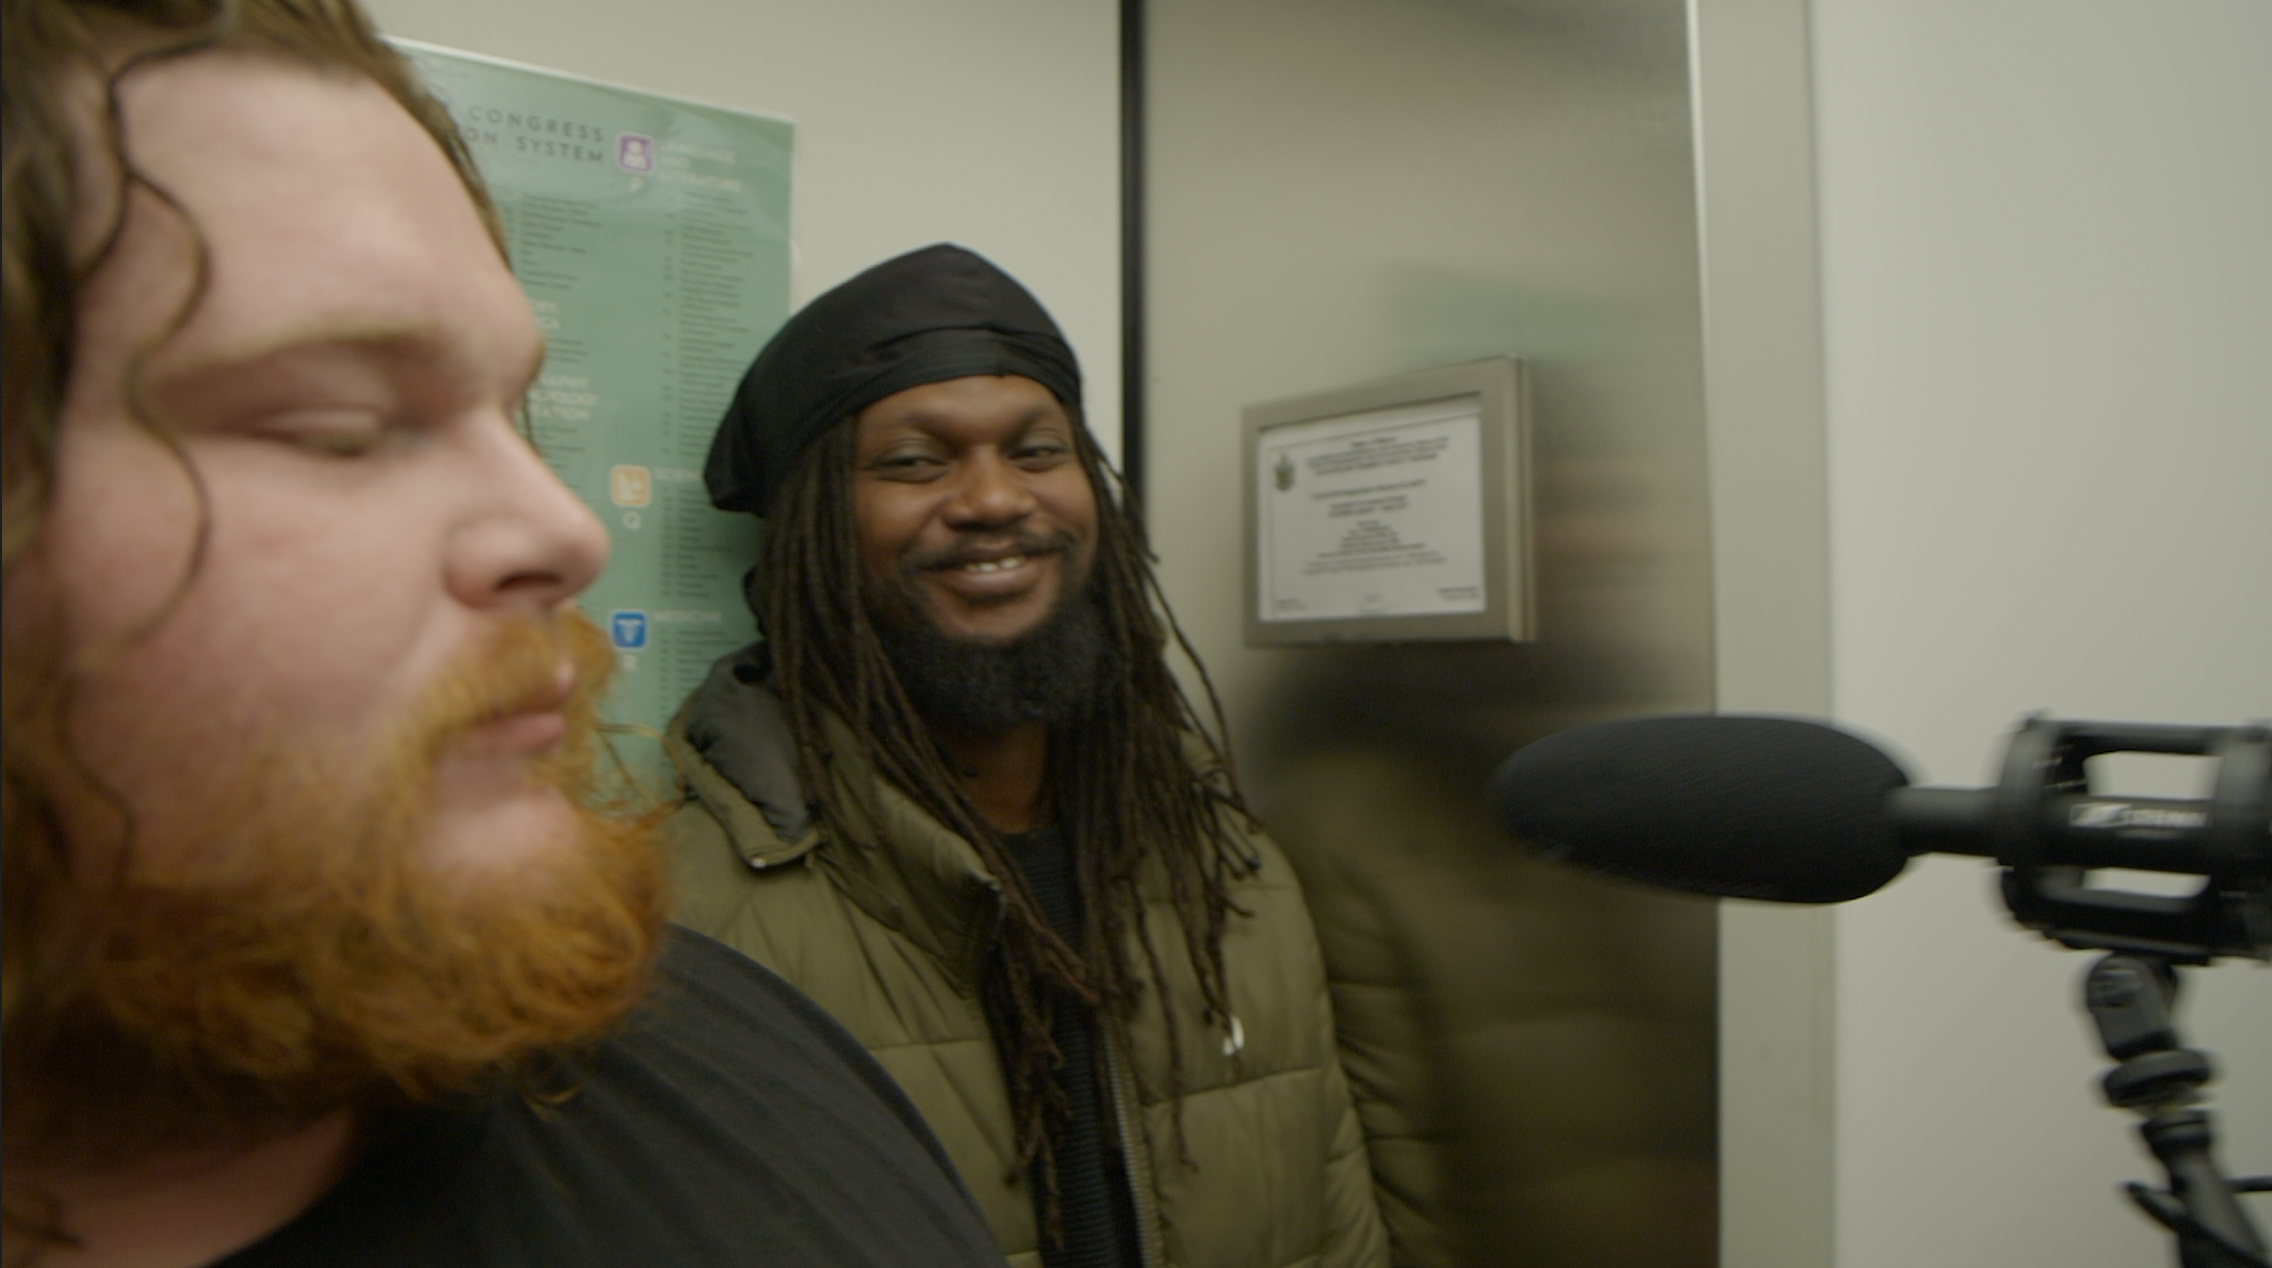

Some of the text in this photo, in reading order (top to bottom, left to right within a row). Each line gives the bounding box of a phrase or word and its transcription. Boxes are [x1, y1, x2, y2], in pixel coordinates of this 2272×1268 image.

[468, 105, 604, 142] CONGRESS
[517, 135, 604, 165] SYSTEM
[630, 175, 644, 193] P
[621, 510, 642, 530] Q
[653, 609, 722, 625] MEDICINE
